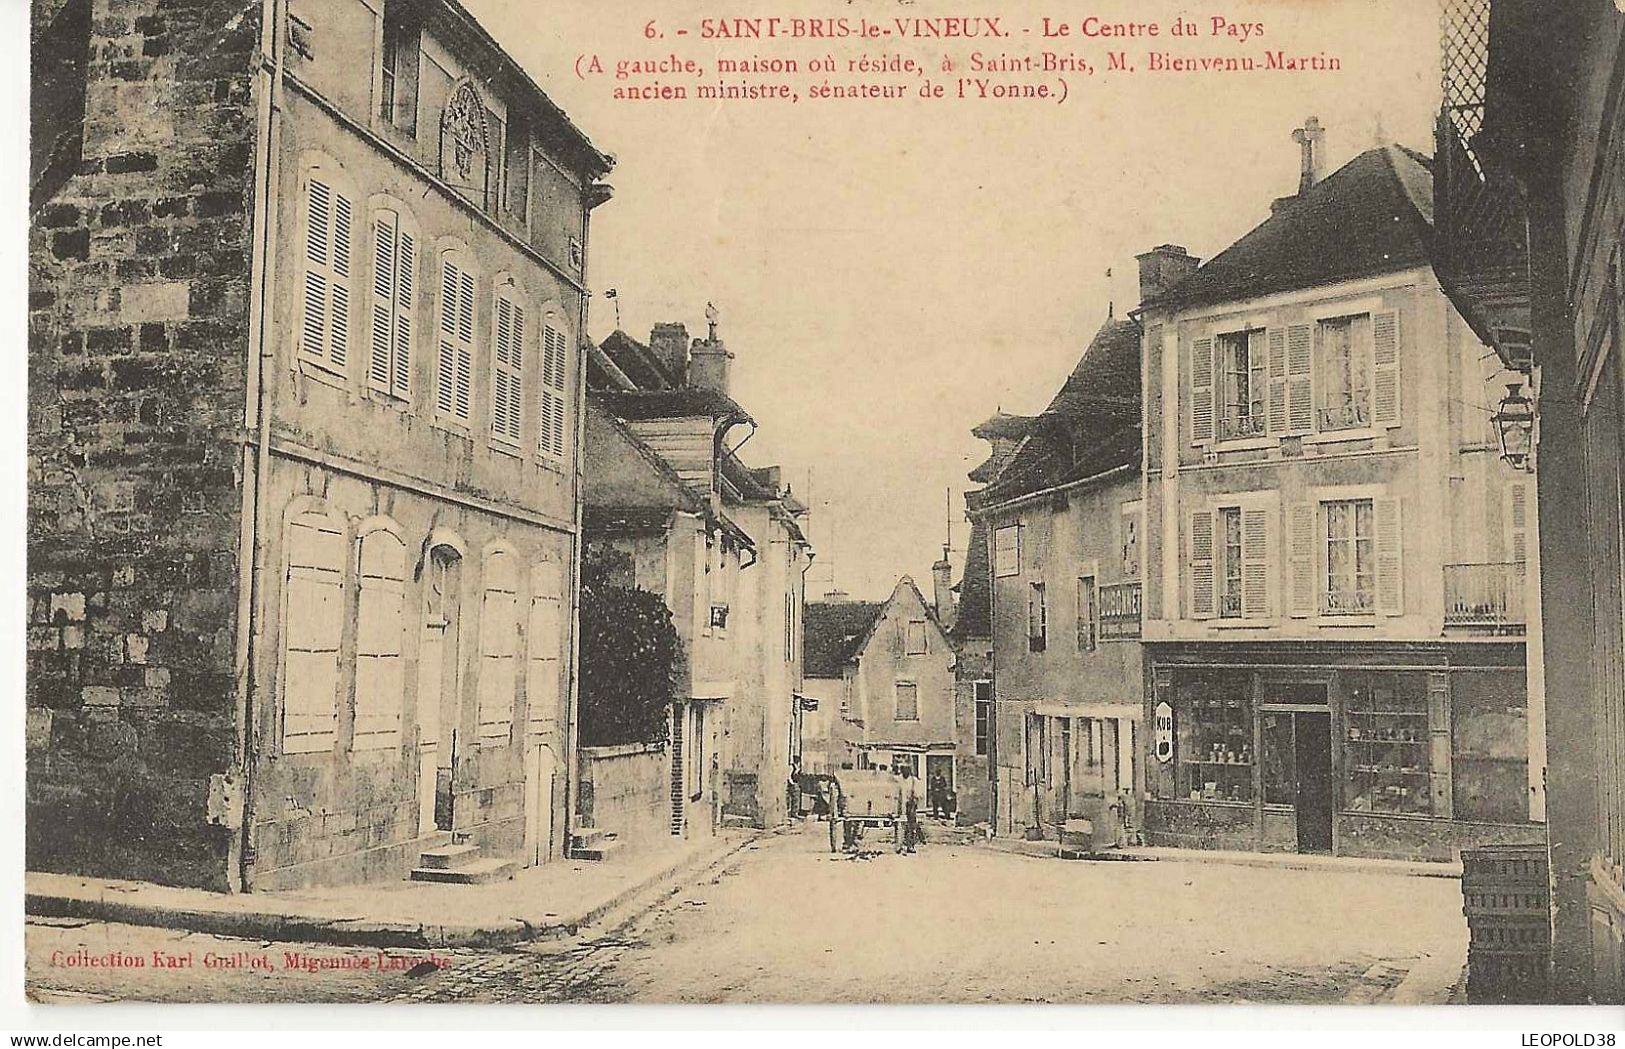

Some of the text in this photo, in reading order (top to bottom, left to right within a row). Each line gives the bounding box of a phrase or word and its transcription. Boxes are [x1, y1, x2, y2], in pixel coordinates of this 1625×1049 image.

[644, 20, 665, 39] 6.
[701, 16, 1010, 40] SAINT-BRIS-le-VINEUX.
[1042, 17, 1071, 38] Le
[1082, 17, 1160, 38] Centre
[1170, 17, 1199, 37] du
[1211, 16, 1265, 43] Pays
[575, 51, 1341, 79] (A gauche, maison où réside, à Saint-Bris, M. Bienvenu-Martin
[613, 80, 687, 100] ancien
[697, 80, 800, 102] ministre,
[809, 80, 908, 100] sénateur
[919, 80, 944, 99] de
[1157, 716, 1171, 731] KUB
[51, 950, 146, 969] Collection
[152, 951, 193, 969] Karl
